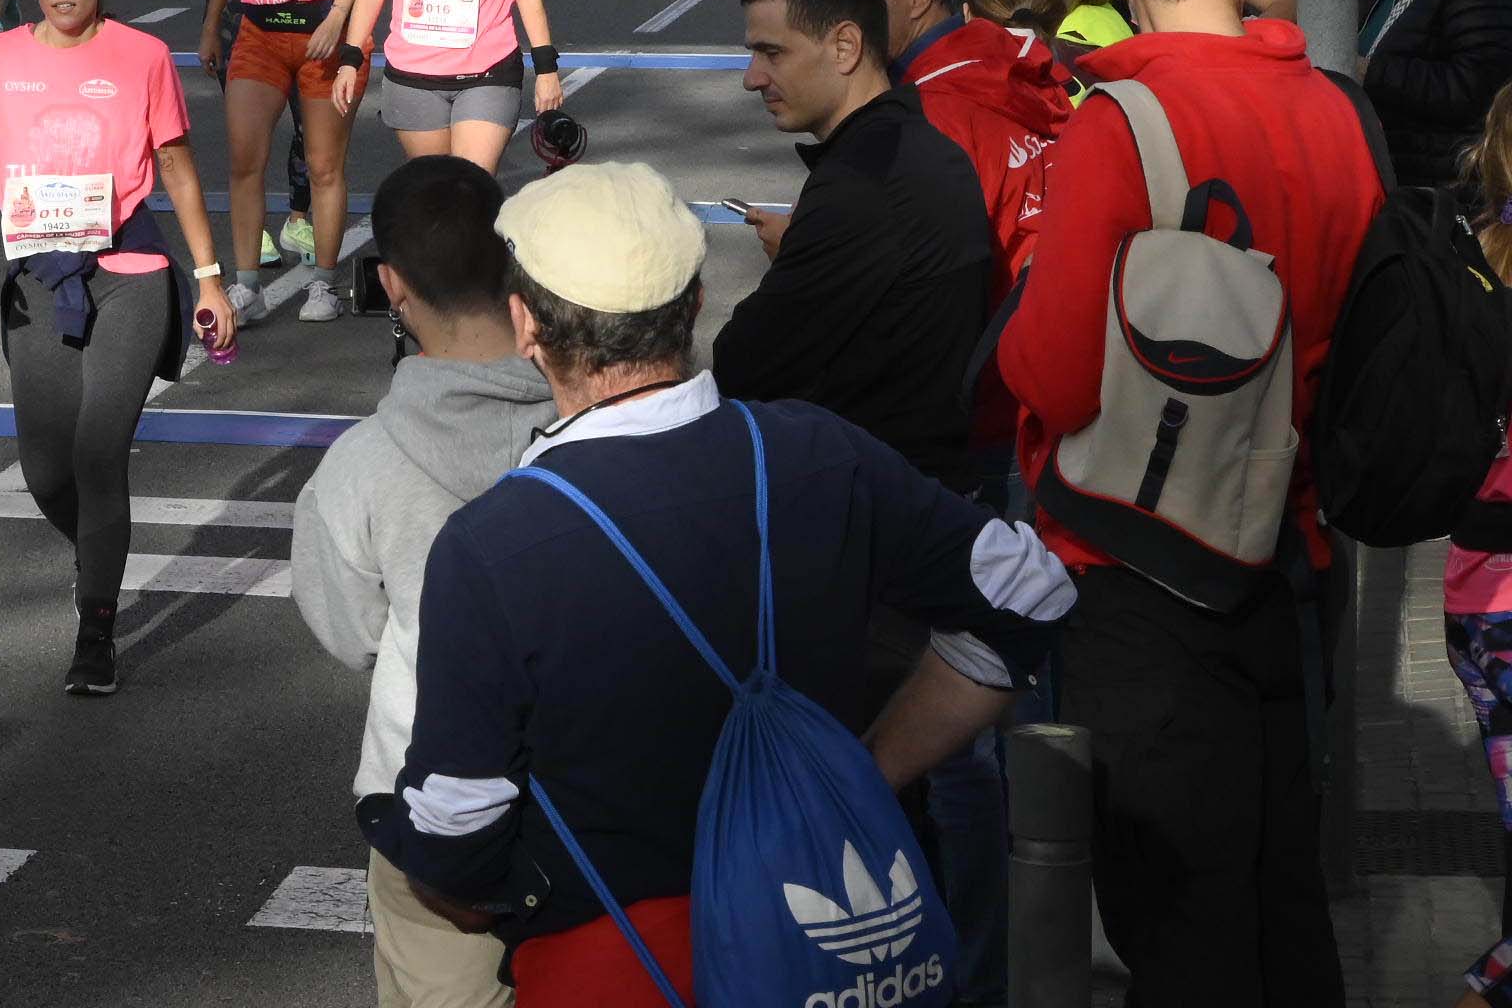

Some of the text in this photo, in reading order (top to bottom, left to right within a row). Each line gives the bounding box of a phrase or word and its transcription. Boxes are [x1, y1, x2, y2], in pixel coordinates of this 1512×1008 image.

[426, 3, 450, 14] 016
[4, 80, 46, 92] OYSHO
[39, 207, 74, 219] 016
[42, 222, 71, 231] 19423
[804, 953, 944, 1008] adidas
